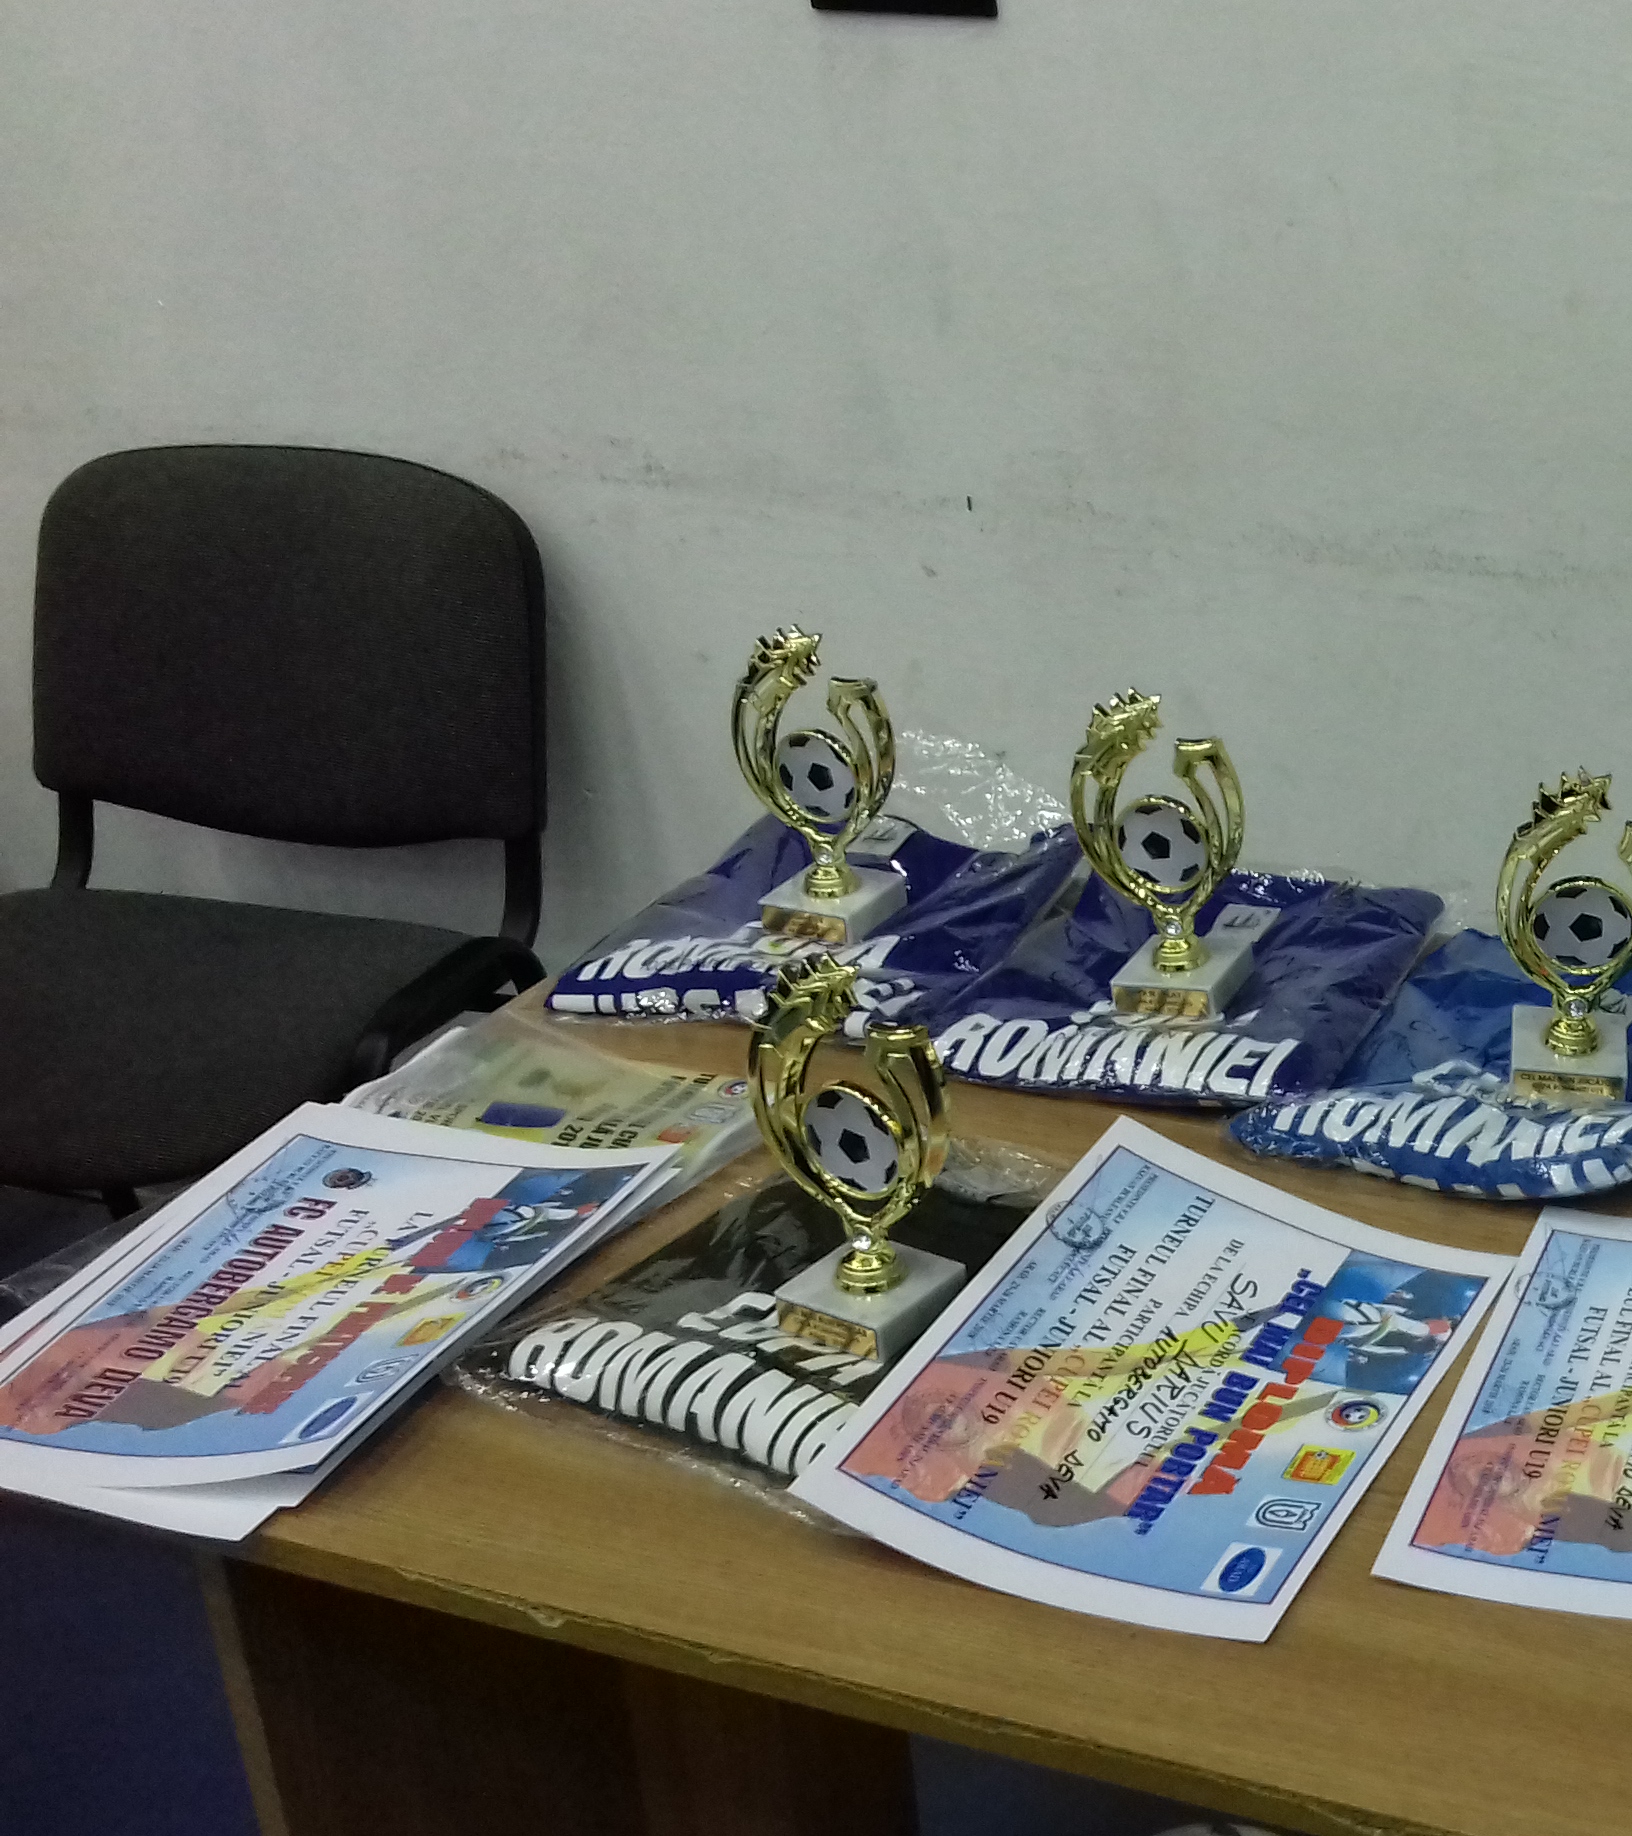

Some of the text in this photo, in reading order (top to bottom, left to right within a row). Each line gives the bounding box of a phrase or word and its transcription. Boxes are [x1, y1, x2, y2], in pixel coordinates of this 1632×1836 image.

[275, 1195, 342, 1222] FC
[1142, 1194, 1217, 1268] TURNEUL
[286, 1208, 371, 1269] FUTSAL
[116, 1223, 311, 1361] AUTOBERGAMO
[1071, 1243, 1139, 1308] FUTSAL
[1101, 1267, 1158, 1319] FINAL
[1172, 1238, 1246, 1318] DE LA ECHIPA
[1080, 1318, 1117, 1345] AL
[1190, 1272, 1266, 1344] SAVU
[1565, 1306, 1609, 1364] FUTSAL
[245, 1315, 320, 1366] FINAL
[1003, 1315, 1080, 1390] JUNIORI
[1238, 1320, 1295, 1369] MAI
[49, 1367, 146, 1419] DEVA
[973, 1389, 1019, 1425] U19
[1065, 1389, 1091, 1409] LA
[1078, 1324, 1186, 1443] AUTOBERGAMO
[1197, 1369, 1260, 1424] BUN
[1587, 1370, 1616, 1392] AL
[1532, 1376, 1580, 1445] JUNIORI
[1517, 1448, 1551, 1480] U19
[1598, 1431, 1619, 1449] LA
[1031, 1447, 1092, 1503] DEVA
